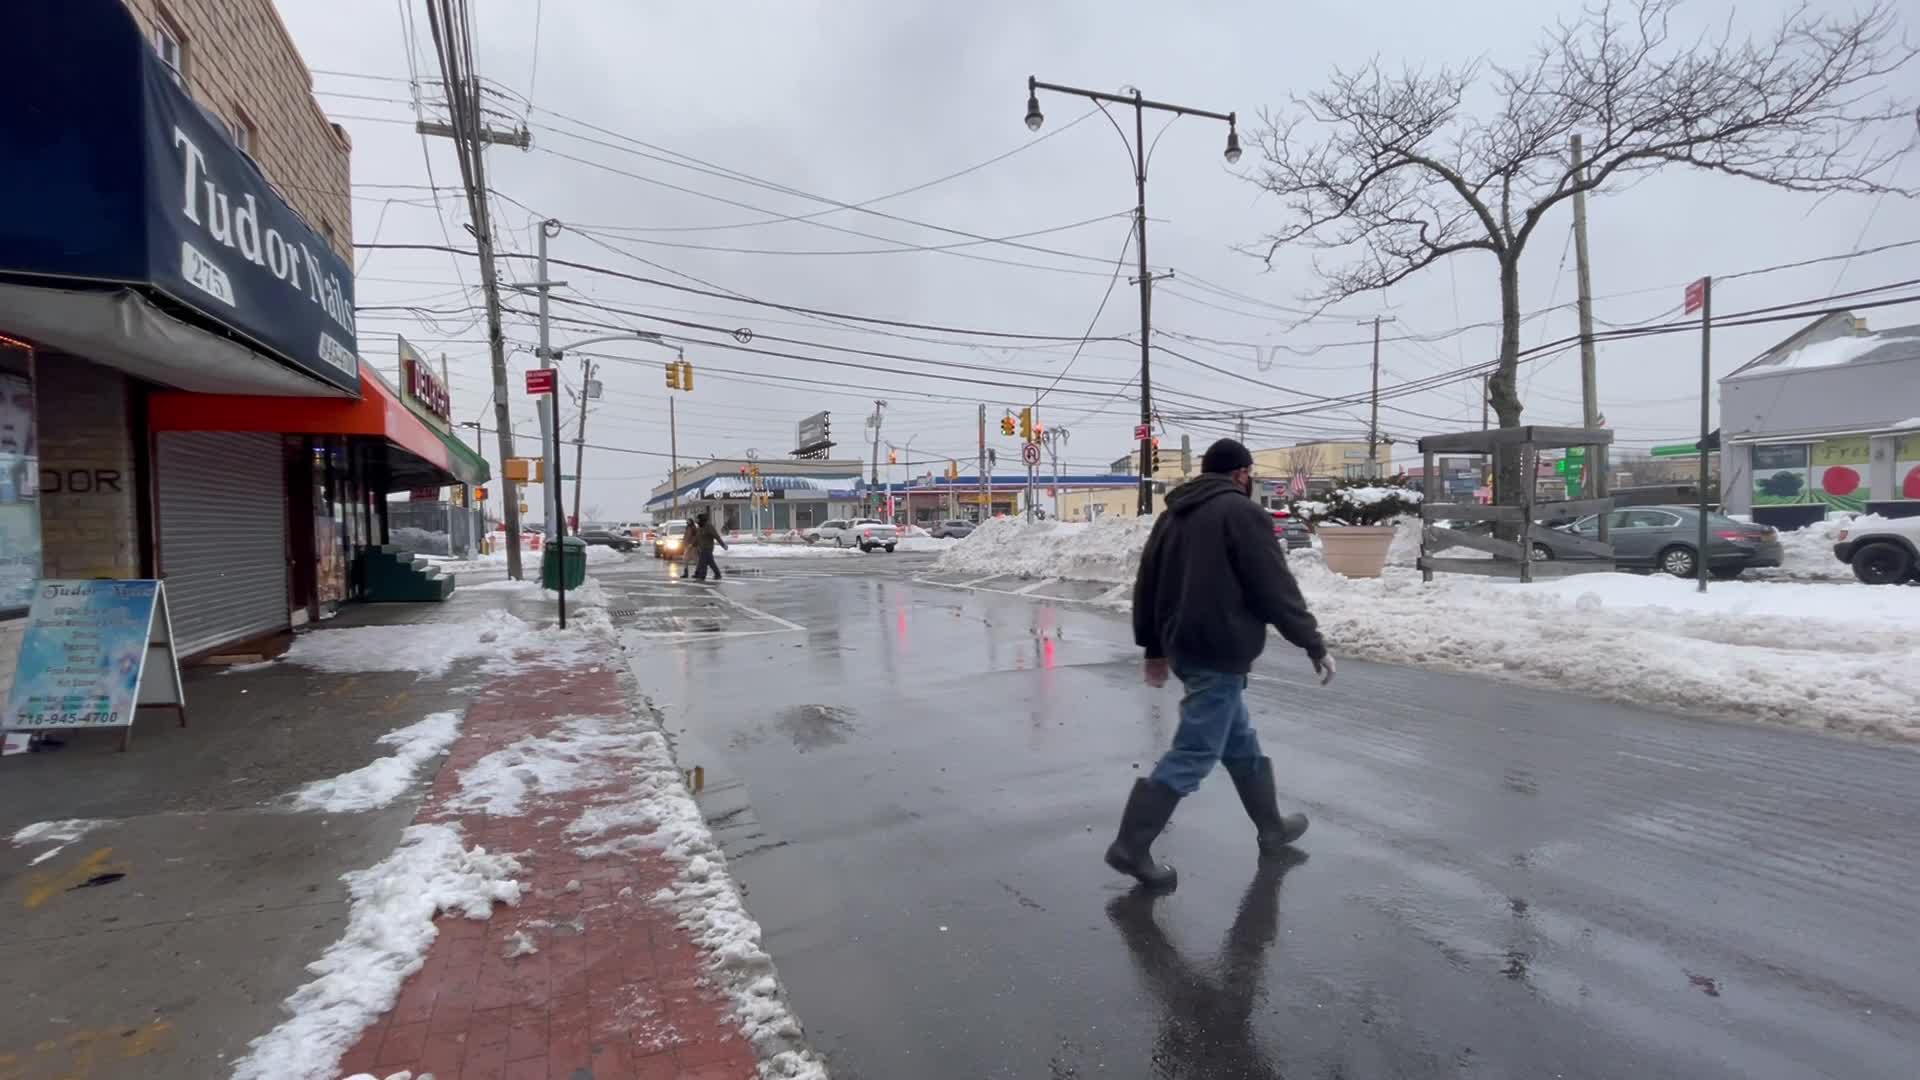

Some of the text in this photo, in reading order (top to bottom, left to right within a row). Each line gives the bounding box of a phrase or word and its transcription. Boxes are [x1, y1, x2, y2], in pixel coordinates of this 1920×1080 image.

[175, 126, 355, 338] Tudor Nails
[192, 251, 225, 298] 275
[16, 711, 119, 726] 718-945-4700
